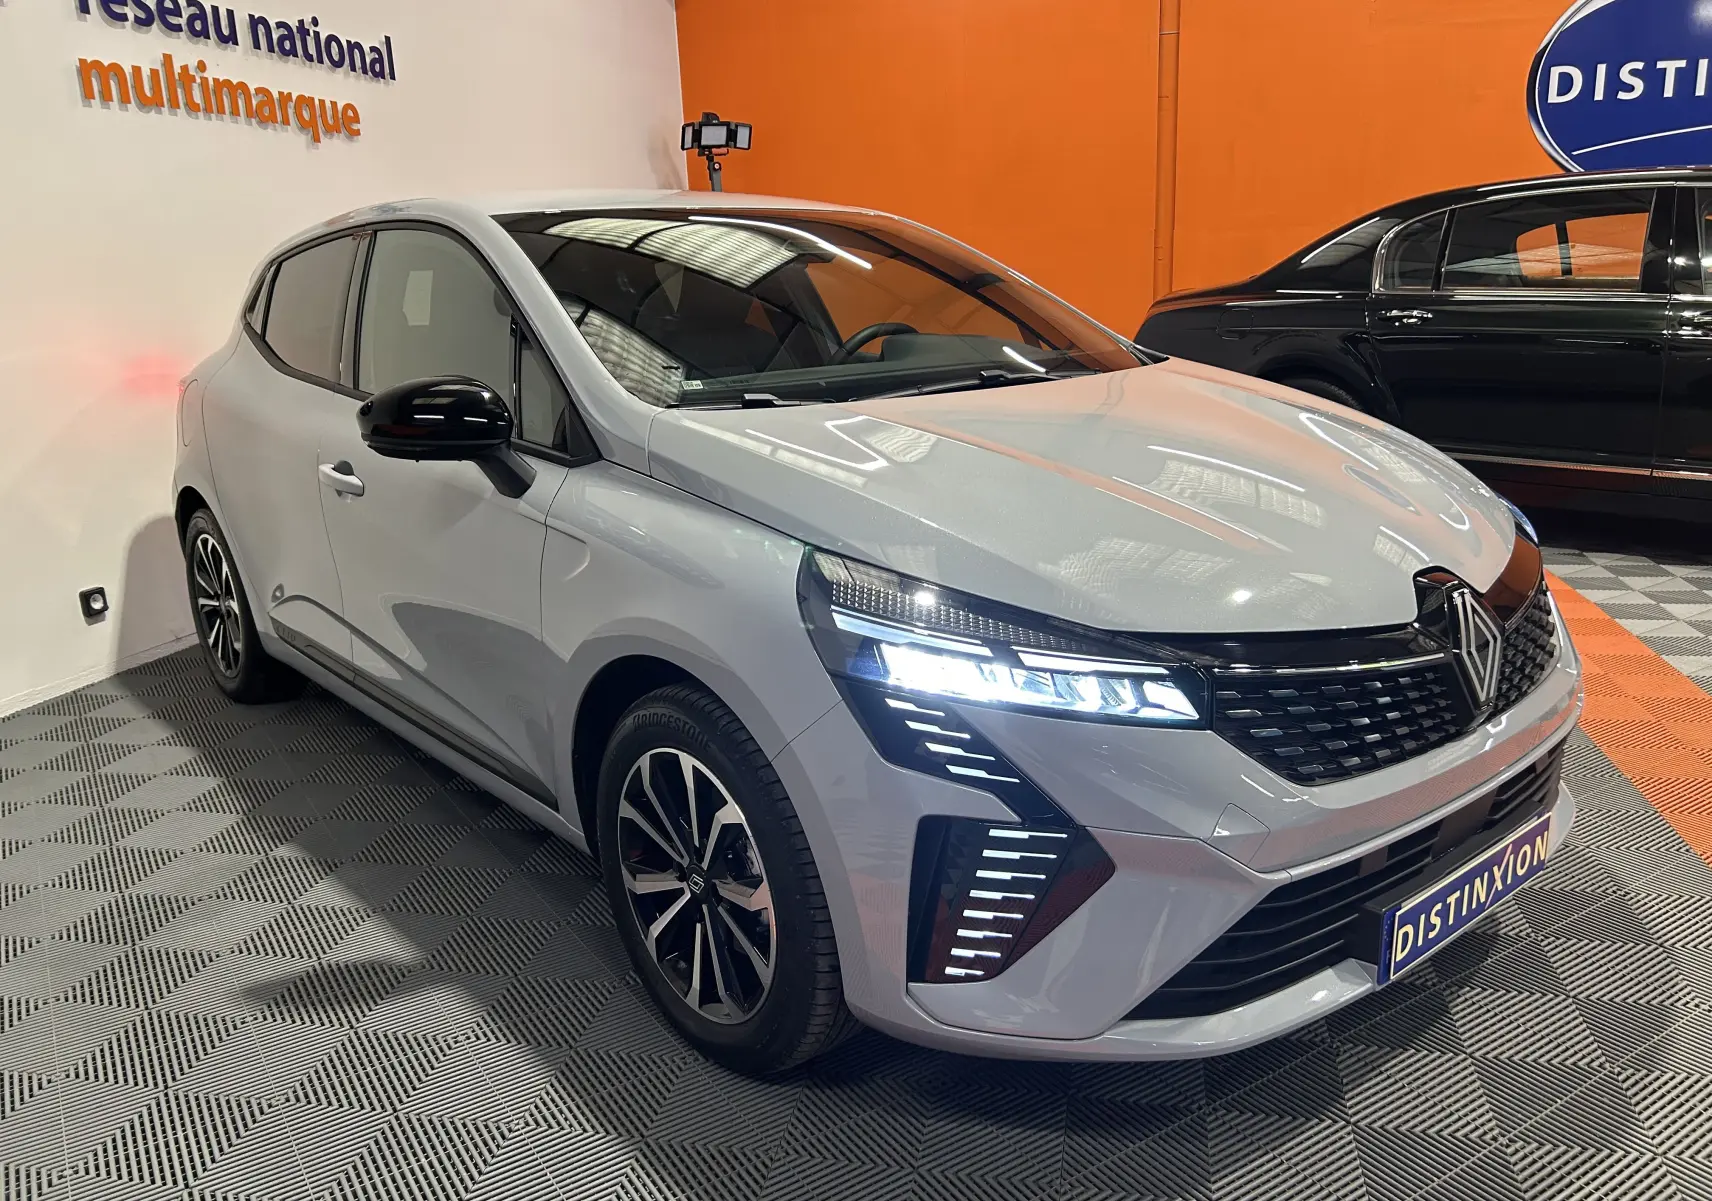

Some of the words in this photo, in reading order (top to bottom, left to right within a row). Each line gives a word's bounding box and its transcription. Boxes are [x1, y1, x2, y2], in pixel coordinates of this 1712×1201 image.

[248, 13, 396, 80] national
[78, 53, 361, 143] multimarque
[1396, 831, 1547, 962] DISTINXION
